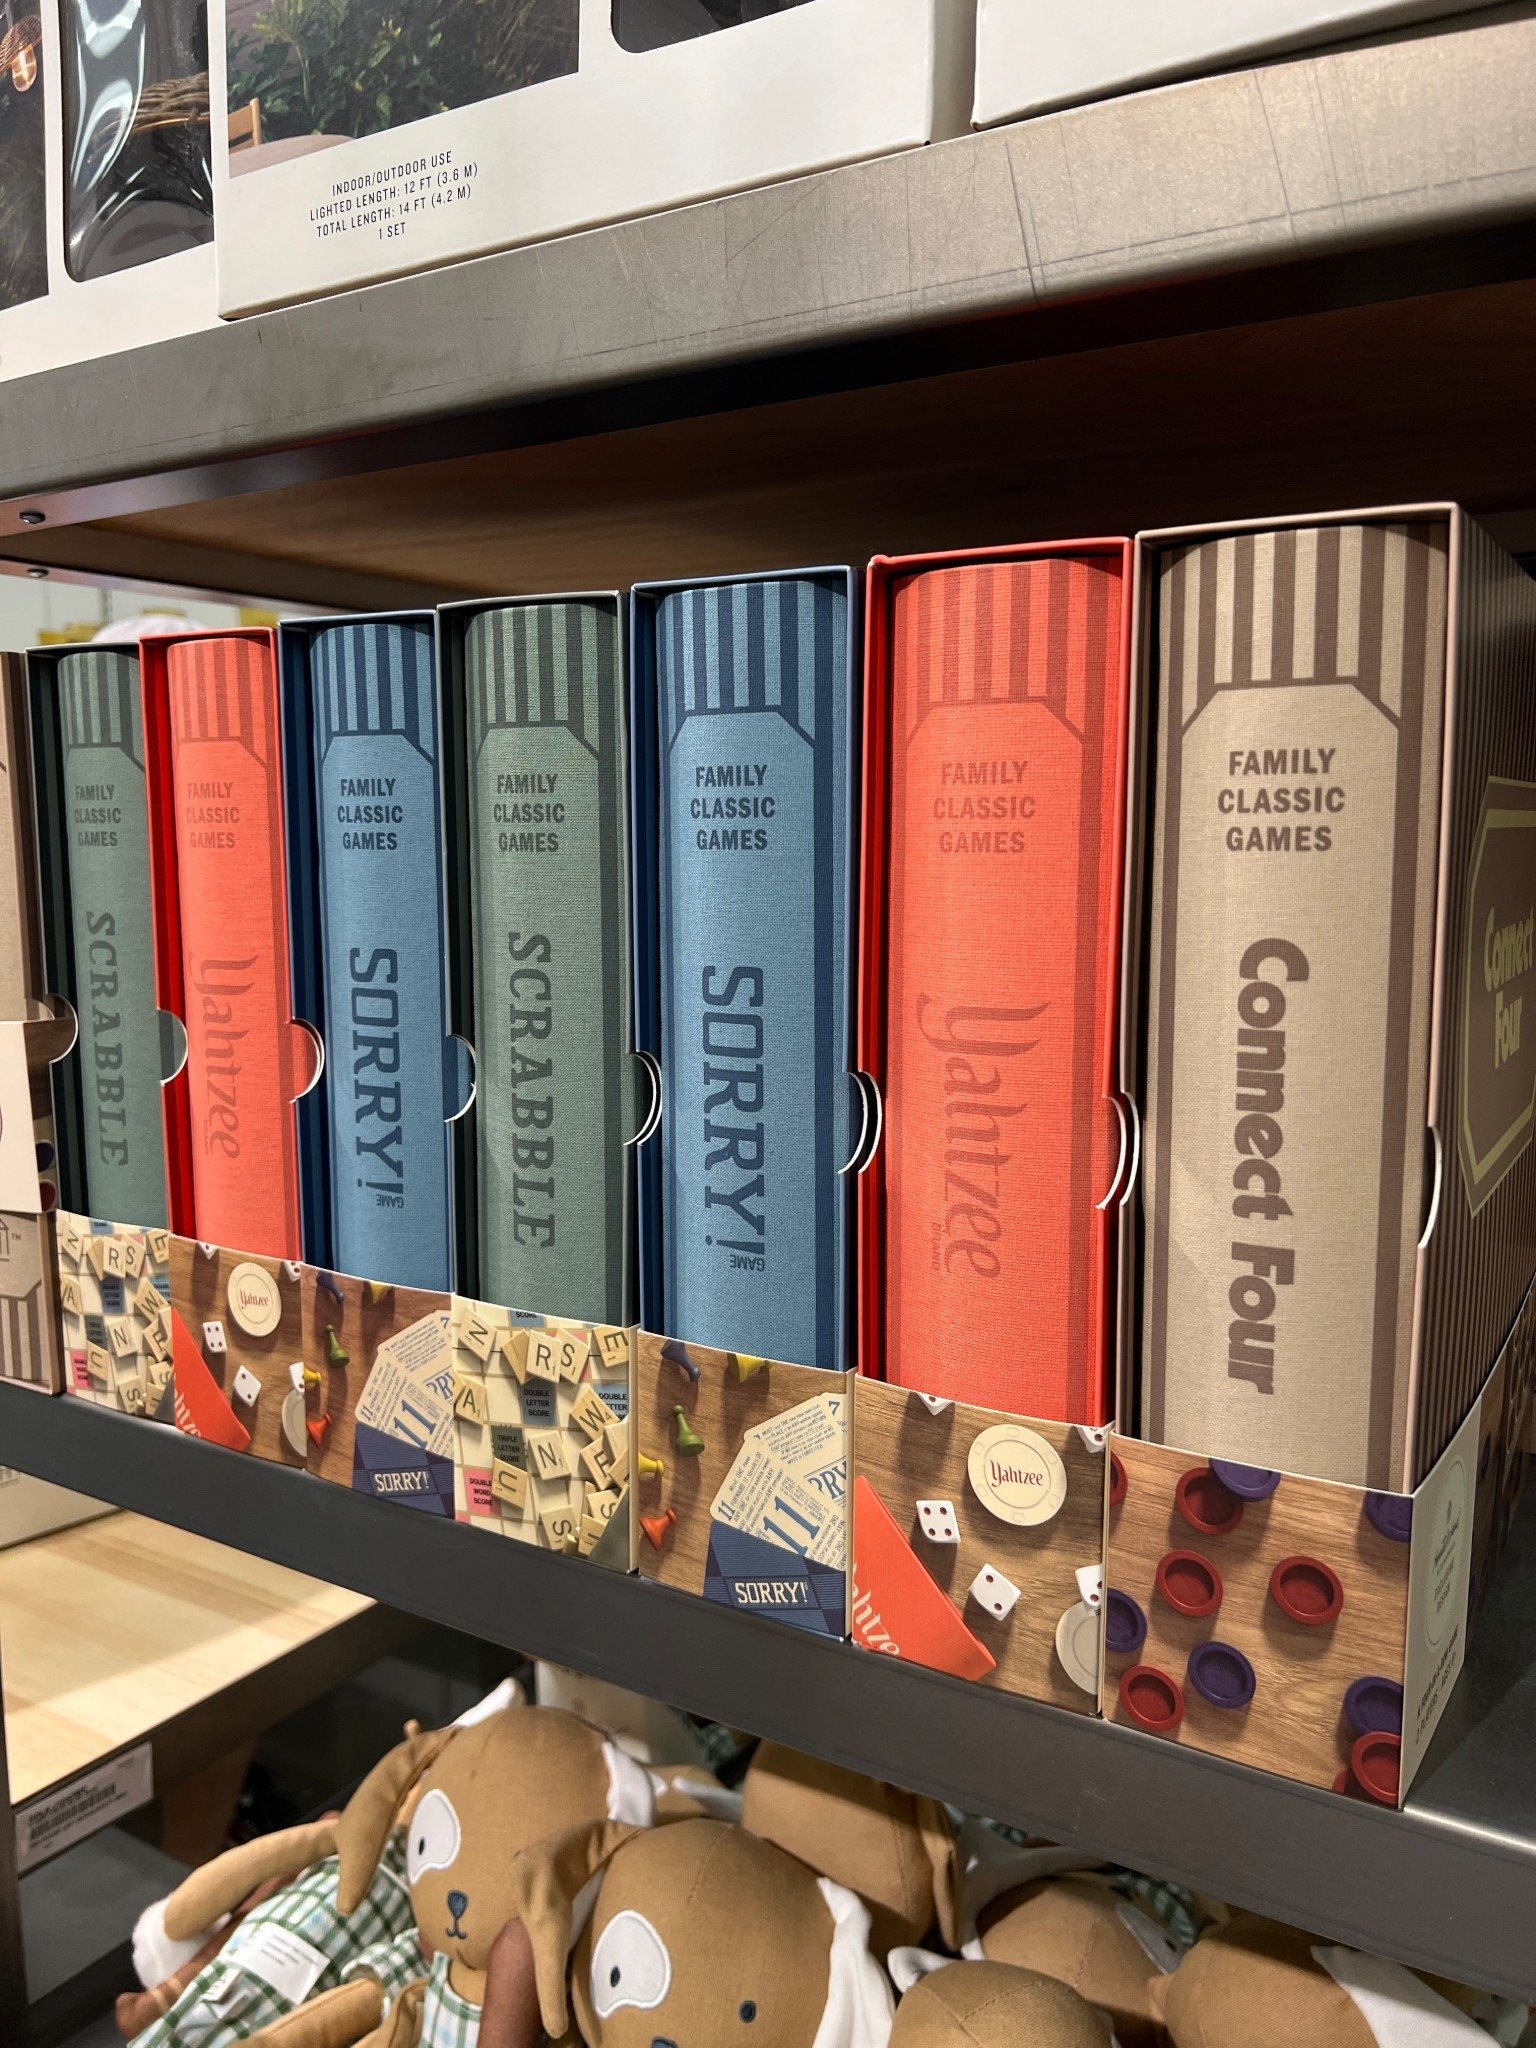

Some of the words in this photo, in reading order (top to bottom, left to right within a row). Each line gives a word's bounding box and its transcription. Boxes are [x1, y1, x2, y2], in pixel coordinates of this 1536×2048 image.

[332, 158, 427, 196] INDOOR/OUTDOOR
[431, 150, 452, 168] USE
[310, 199, 352, 221] LIGHTED
[356, 186, 400, 208] LENGTH:
[404, 181, 416, 195] 12
[420, 176, 432, 191] FT
[437, 168, 459, 187] (3.6
[464, 162, 478, 178] M)
[317, 219, 347, 238] TOTAL
[351, 206, 395, 228] LENGTH:
[399, 203, 410, 216] 14
[414, 197, 426, 211] FT
[431, 189, 453, 209] (4.2
[457, 184, 471, 199] M)
[378, 228, 383, 239] 1
[387, 222, 406, 238] SET
[940, 761, 1028, 785] FAMILY
[1228, 747, 1336, 777] FAMILY
[497, 773, 559, 794] FAMILY
[695, 764, 768, 786] FAMILY
[75, 783, 115, 801] FAMILY
[187, 781, 234, 800] FAMILY
[340, 778, 396, 797] FAMILY
[690, 797, 776, 819] CLASSIC
[933, 796, 1036, 820] CLASSIC
[1218, 786, 1345, 814] CLASSIC
[74, 804, 122, 825] CLASSIC
[186, 803, 240, 824] CLASSIC
[338, 803, 403, 824] CLASSIC
[493, 802, 565, 824] CLASSIC
[77, 831, 118, 848] GAMES
[190, 830, 236, 849] GAMES
[342, 831, 398, 850] GAMES
[498, 832, 559, 853] GAMES
[696, 829, 768, 851] GAMES
[939, 832, 1026, 854] GAMES
[1226, 825, 1333, 852] GAMES
[1483, 904, 1535, 993] Connect
[85, 911, 129, 1167] SCRABBLE
[1494, 990, 1523, 1071] Four
[190, 951, 259, 1159] Yahtzee
[349, 946, 404, 1194] SORRY!
[1232, 937, 1310, 1222] Connect
[508, 931, 556, 1249] SCRABBLE
[702, 964, 765, 1255] SORRY!
[916, 991, 1052, 1278] Yahtzee
[376, 1194, 404, 1208] GAME
[108, 1247, 119, 1268] R
[126, 1245, 135, 1265] S
[729, 1254, 765, 1272] GAME
[239, 1290, 270, 1309] Yahtzee
[1227, 1240, 1294, 1396] Four
[536, 1343, 551, 1370] R
[561, 1343, 576, 1367] S
[462, 1389, 476, 1413] A
[523, 1389, 550, 1397] DOUBLE
[526, 1399, 550, 1407] LETTER
[599, 1393, 628, 1401] DOUBLE
[528, 1409, 550, 1417] SCORE
[579, 1400, 606, 1432] W
[828, 1400, 840, 1416] 7
[497, 1434, 518, 1443] TRIPLE
[498, 1445, 520, 1453] LETTER
[537, 1442, 557, 1469] N
[374, 1471, 430, 1492] SORRY!
[469, 1477, 492, 1487] DOUBLE
[990, 1459, 1044, 1488] Yahtzee
[473, 1488, 491, 1496] WORD
[473, 1497, 493, 1506] SCORE
[717, 1499, 736, 1522] 11
[763, 1495, 821, 1557] 11
[735, 1581, 809, 1605] SORRY!
